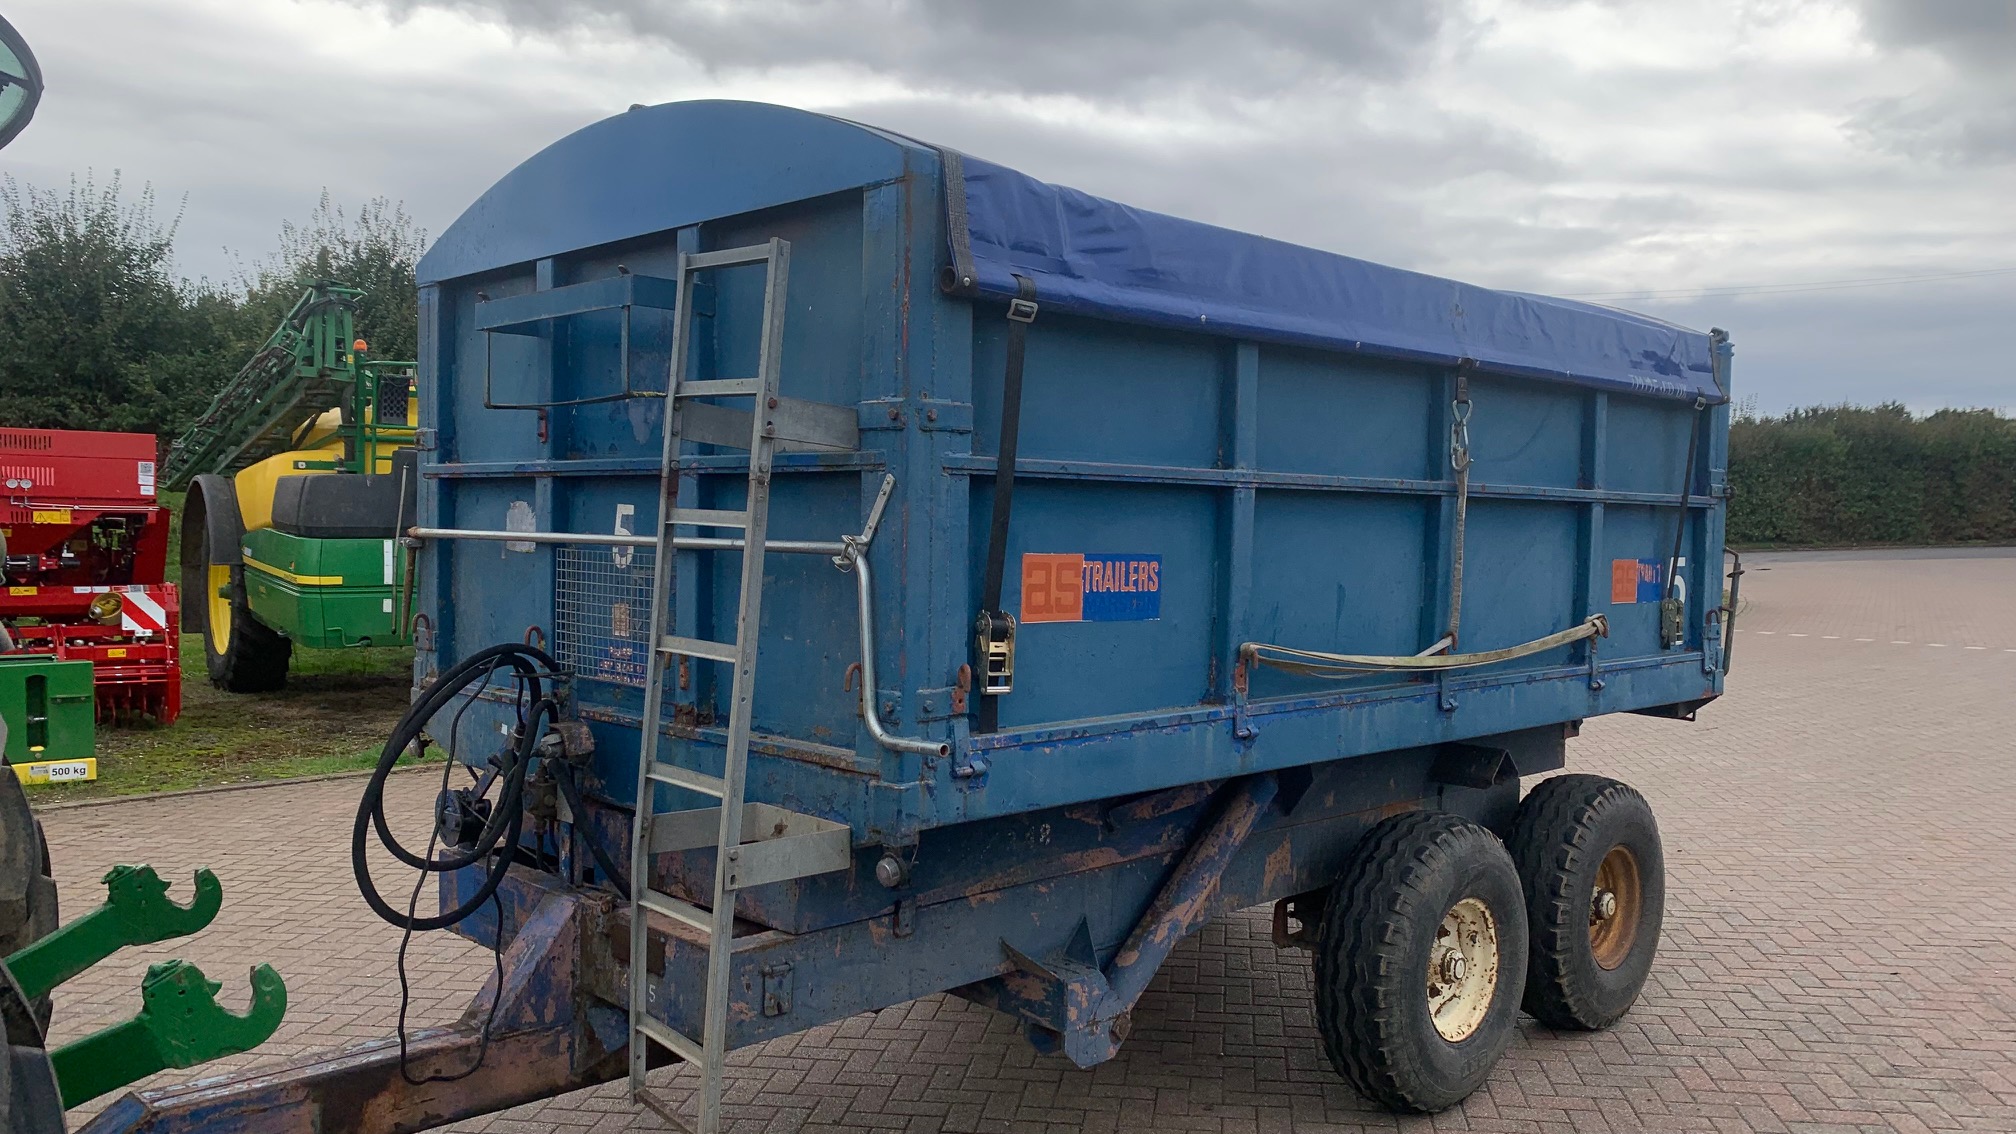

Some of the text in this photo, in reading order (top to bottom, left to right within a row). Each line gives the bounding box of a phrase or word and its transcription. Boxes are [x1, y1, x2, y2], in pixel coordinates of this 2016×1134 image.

[1083, 560, 1159, 592] TRAILERS
[52, 767, 70, 776] 500
[74, 766, 86, 775] kg
